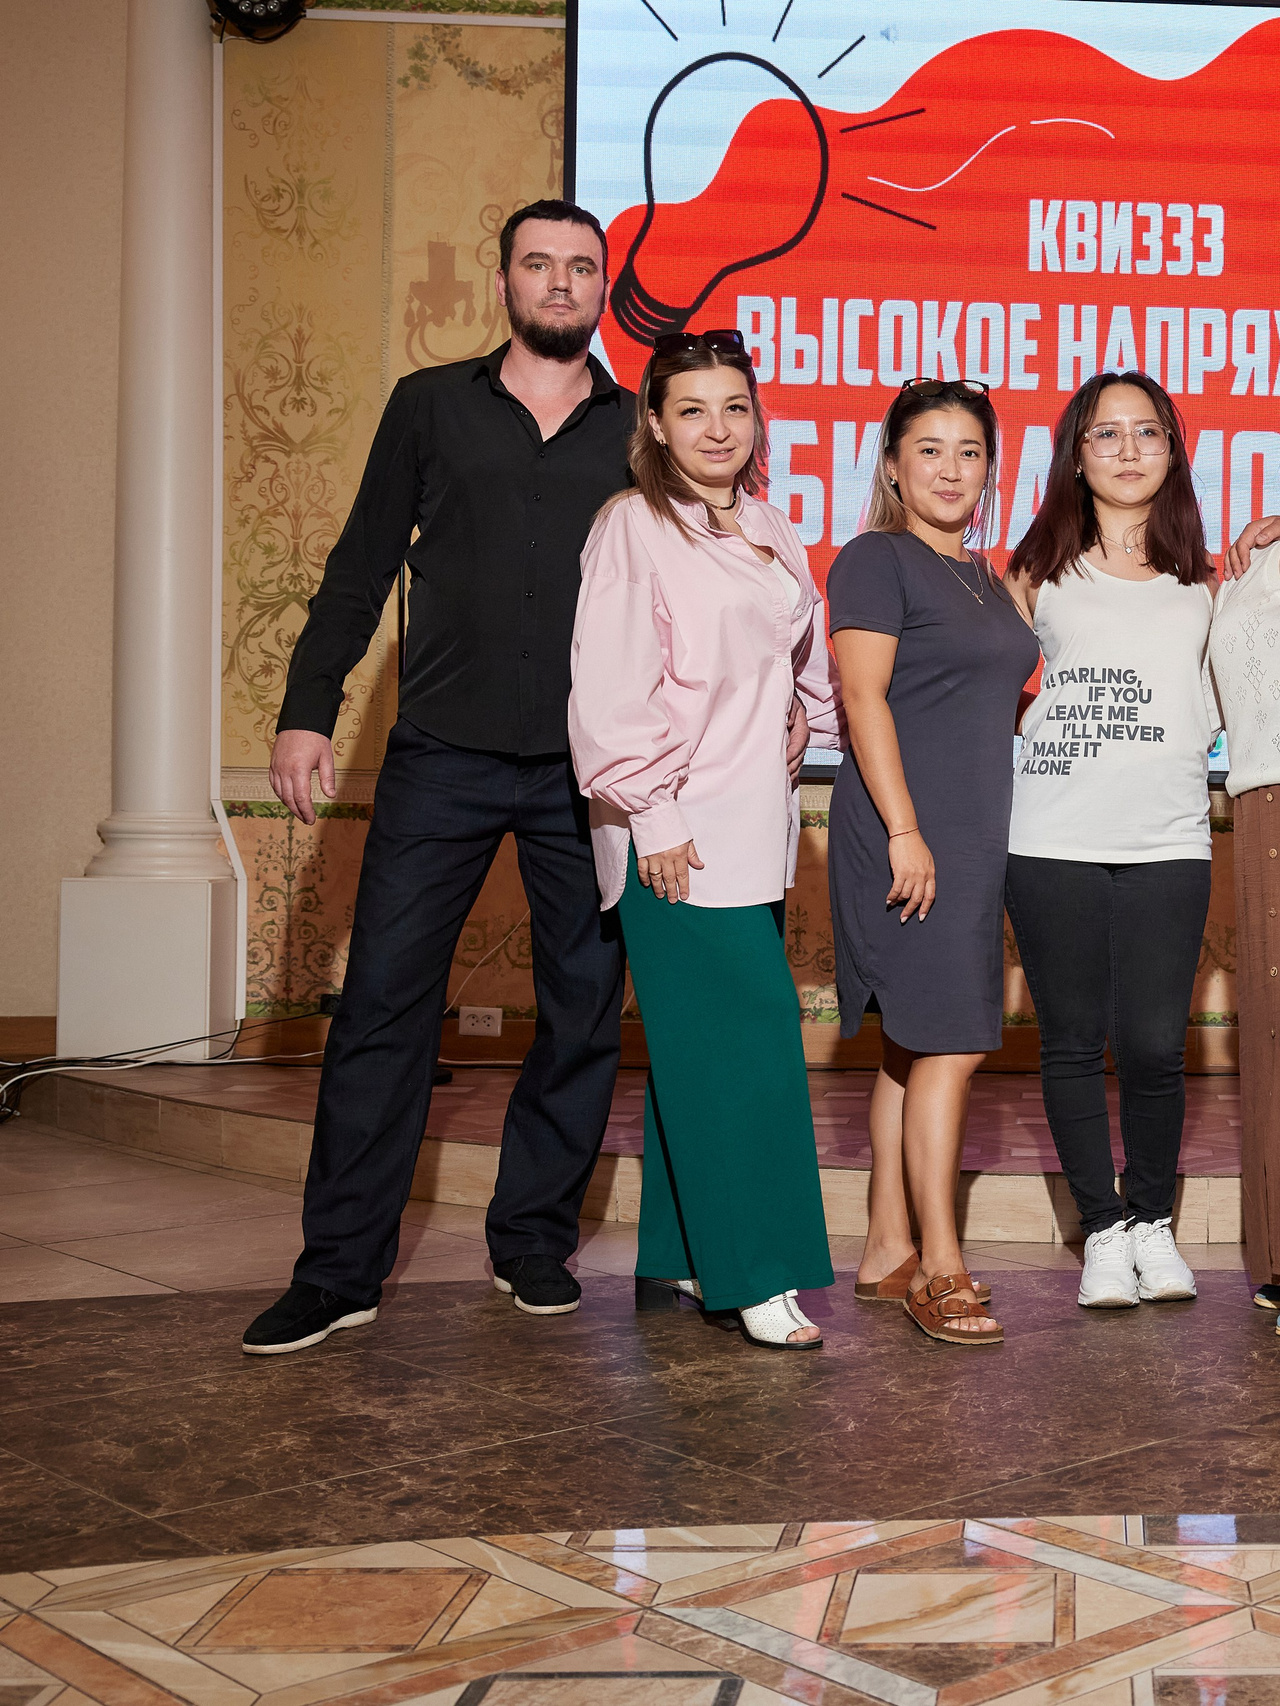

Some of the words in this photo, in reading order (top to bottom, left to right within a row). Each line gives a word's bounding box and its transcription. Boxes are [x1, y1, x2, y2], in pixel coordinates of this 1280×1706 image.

[1028, 199, 1225, 276] КВИЗЗЗ
[736, 295, 1040, 387] ВЫСОКОЕ
[1058, 667, 1142, 688] DARLING,
[1088, 686, 1106, 702] IF
[1110, 686, 1152, 704] YOU
[1046, 705, 1103, 721] LEAVE
[1107, 706, 1139, 722] ME
[1062, 723, 1092, 739] I'LL
[1096, 724, 1165, 742] NEVER
[1032, 742, 1080, 757] MAKE
[1083, 742, 1102, 757] IT
[1021, 760, 1072, 775] ALONE
